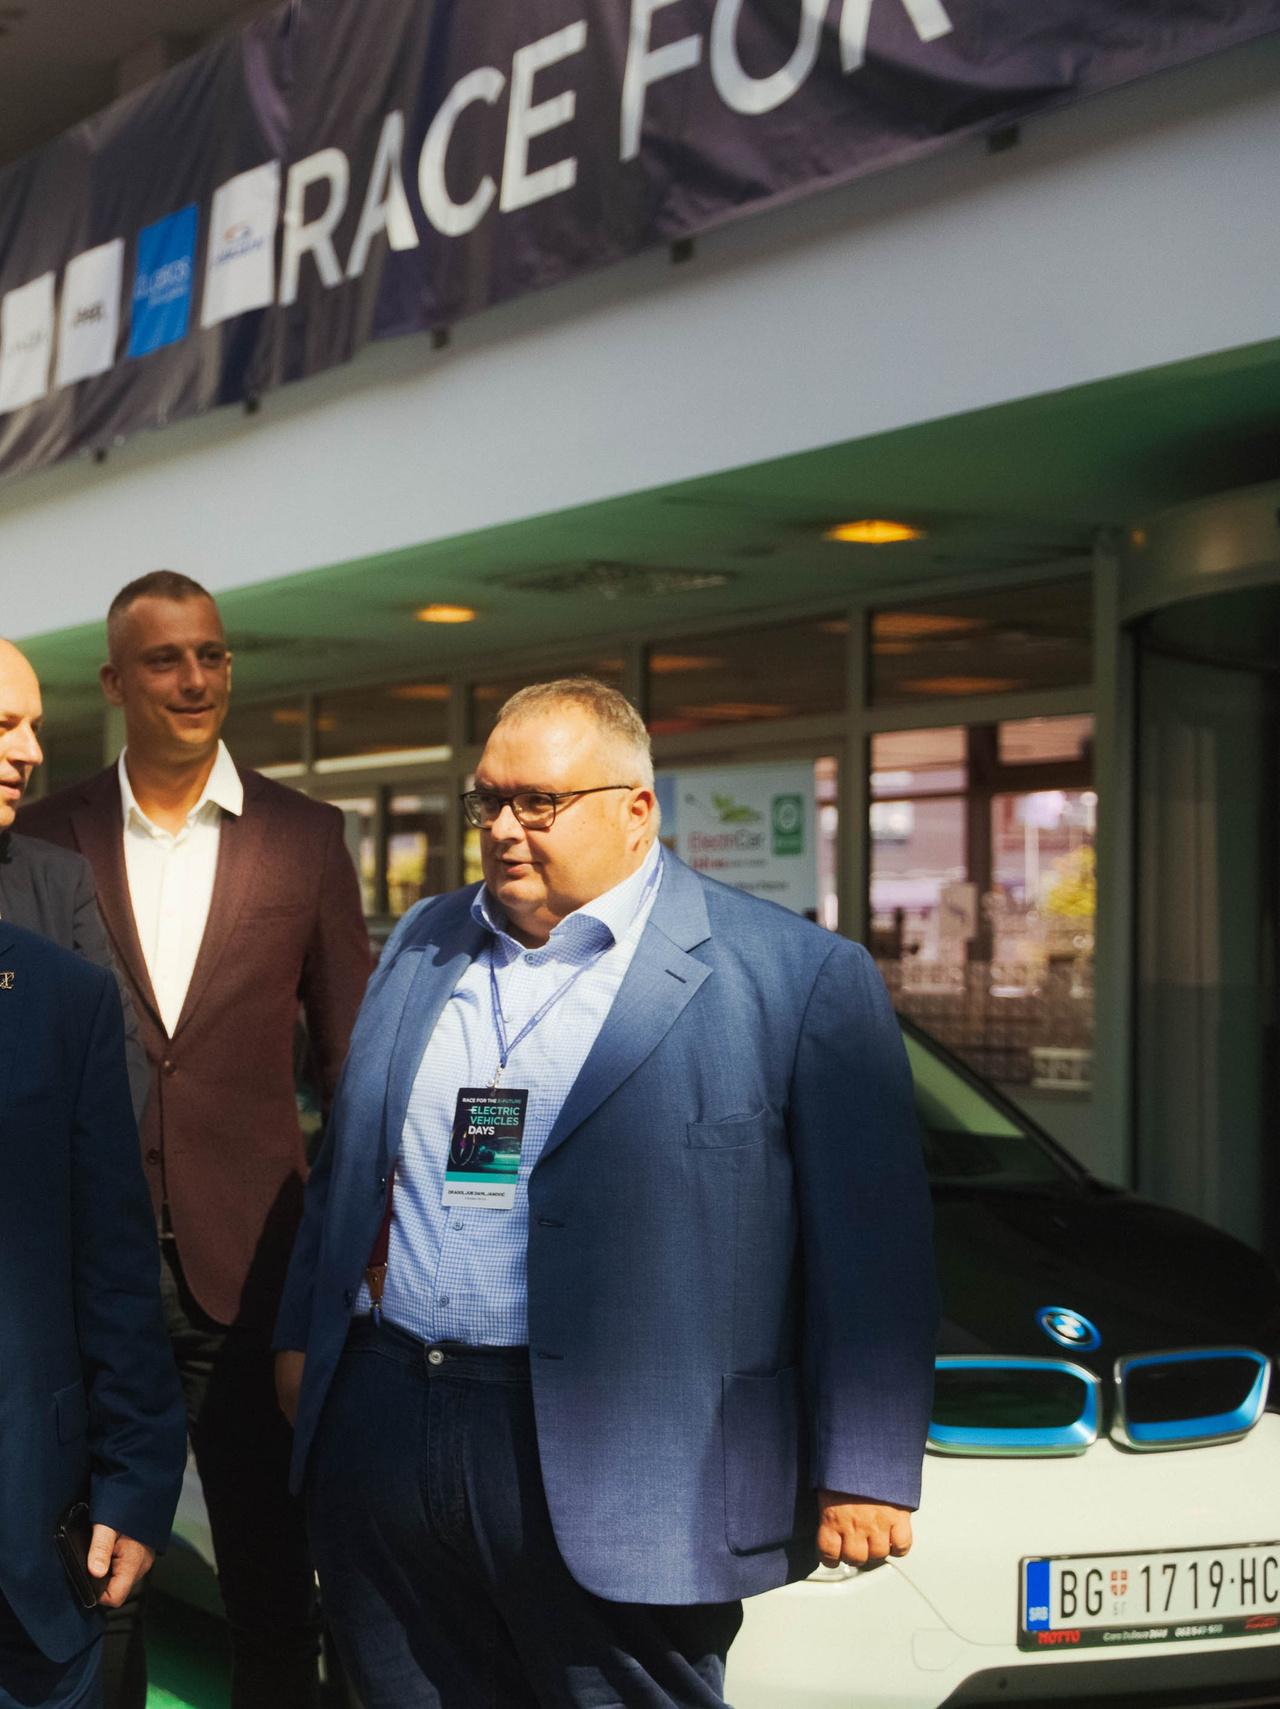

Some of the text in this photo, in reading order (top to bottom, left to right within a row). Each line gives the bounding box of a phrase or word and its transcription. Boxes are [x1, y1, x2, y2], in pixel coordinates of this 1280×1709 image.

[279, 19, 588, 308] RACE
[471, 1105, 520, 1116] ELECTRIC
[470, 1116, 519, 1126] VEHICLES
[468, 1125, 495, 1135] DAYS
[1060, 1568, 1103, 1618] BG
[1038, 1629, 1080, 1645] MOTTO
